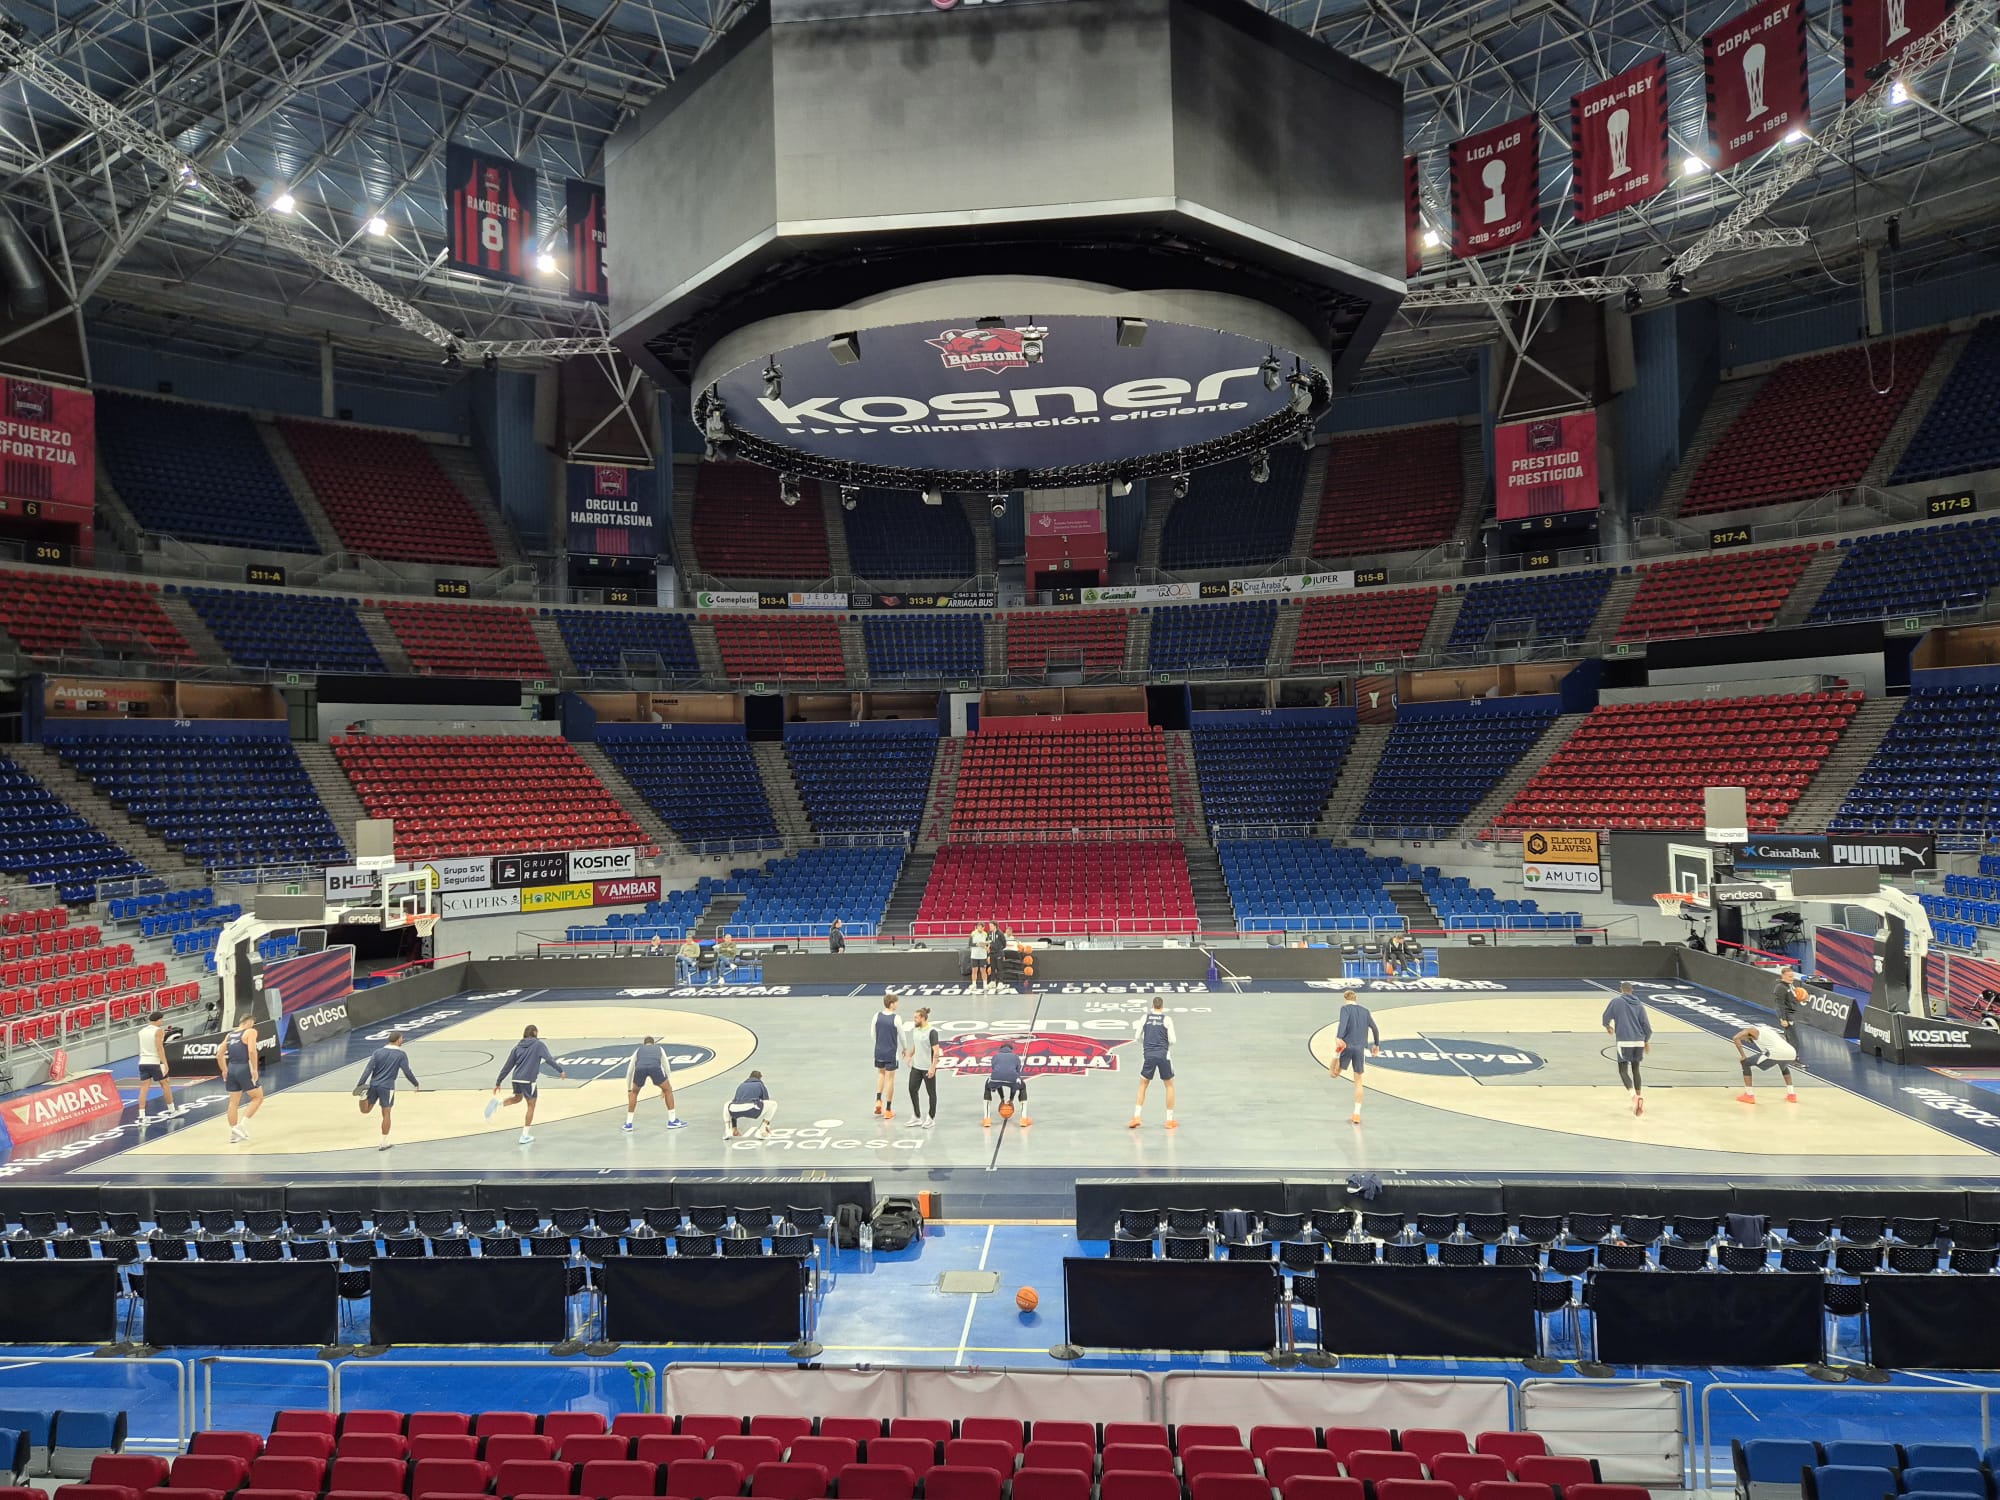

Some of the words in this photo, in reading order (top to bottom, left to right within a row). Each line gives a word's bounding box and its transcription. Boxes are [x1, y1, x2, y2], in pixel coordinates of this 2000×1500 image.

[1717, 33, 1750, 56] COPA
[1750, 24, 1762, 35] DEL
[1763, 5, 1790, 32] REY
[1584, 98, 1616, 118] COPA
[1628, 76, 1654, 98] REY
[1729, 131, 1754, 150] 1998
[1763, 112, 1788, 133] 1999
[1466, 144, 1493, 162] LIGA
[1496, 132, 1521, 153] ACB
[1592, 187, 1616, 205] 1994
[467, 195, 517, 221] RAKOCEVIC
[482, 217, 504, 252] 8
[1498, 221, 1522, 238] 2020
[948, 351, 1025, 365] BASKONI
[757, 367, 1260, 424] kosner
[889, 415, 1100, 434] Climatización
[1111, 401, 1248, 421] eficiente
[0, 421, 72, 446] SFUERZO
[1512, 451, 1579, 472] PRESTIGIO
[1508, 466, 1584, 487] PRESTIGIOA
[27, 503, 37, 515] 6
[586, 499, 638, 512] ORGULLO
[1931, 498, 1971, 512] 317-B
[571, 512, 653, 527] HARROTASUNA
[1544, 518, 1552, 528] 9
[1713, 531, 1748, 544] 317-A
[37, 547, 60, 559] 310
[610, 558, 617, 567] 7
[1063, 560, 1070, 569] 8
[1530, 555, 1549, 565] 316
[251, 570, 281, 581] 311-A
[1312, 575, 1338, 586] JUPER
[1357, 573, 1384, 582] 315-B
[437, 584, 467, 594] 311-B
[1201, 586, 1227, 594] 315-A
[611, 593, 628, 601] 312
[760, 597, 786, 605] 313-A
[909, 597, 933, 605] 313-B
[948, 599, 978, 607] ARRIAGA
[978, 598, 994, 607] BUS
[1059, 593, 1074, 601] 314
[1551, 836, 1592, 845] ELECTRO
[1759, 846, 1821, 859] CaixaBank
[1832, 845, 1901, 865] PUMA
[523, 858, 562, 868] GRUPO
[573, 854, 631, 870] kosner
[444, 866, 468, 875] Grupo
[470, 864, 485, 872] SVC
[523, 869, 562, 879] REGUI
[329, 876, 354, 890] BH
[444, 875, 485, 885] Seguridad
[1545, 871, 1598, 882] AMUTIO
[609, 882, 656, 897] AMBAR
[1720, 890, 1763, 900] endesa
[443, 896, 508, 911] SCALPERS
[348, 914, 381, 925] endes
[1800, 993, 1850, 1020] ndesa
[299, 1004, 348, 1030] endesa
[1908, 1029, 1969, 1042] kosner
[183, 1042, 220, 1055] kosn
[938, 1055, 1112, 1068] BASONIA
[34, 1084, 109, 1123] AMBAR
[731, 1137, 924, 1150] endesa
